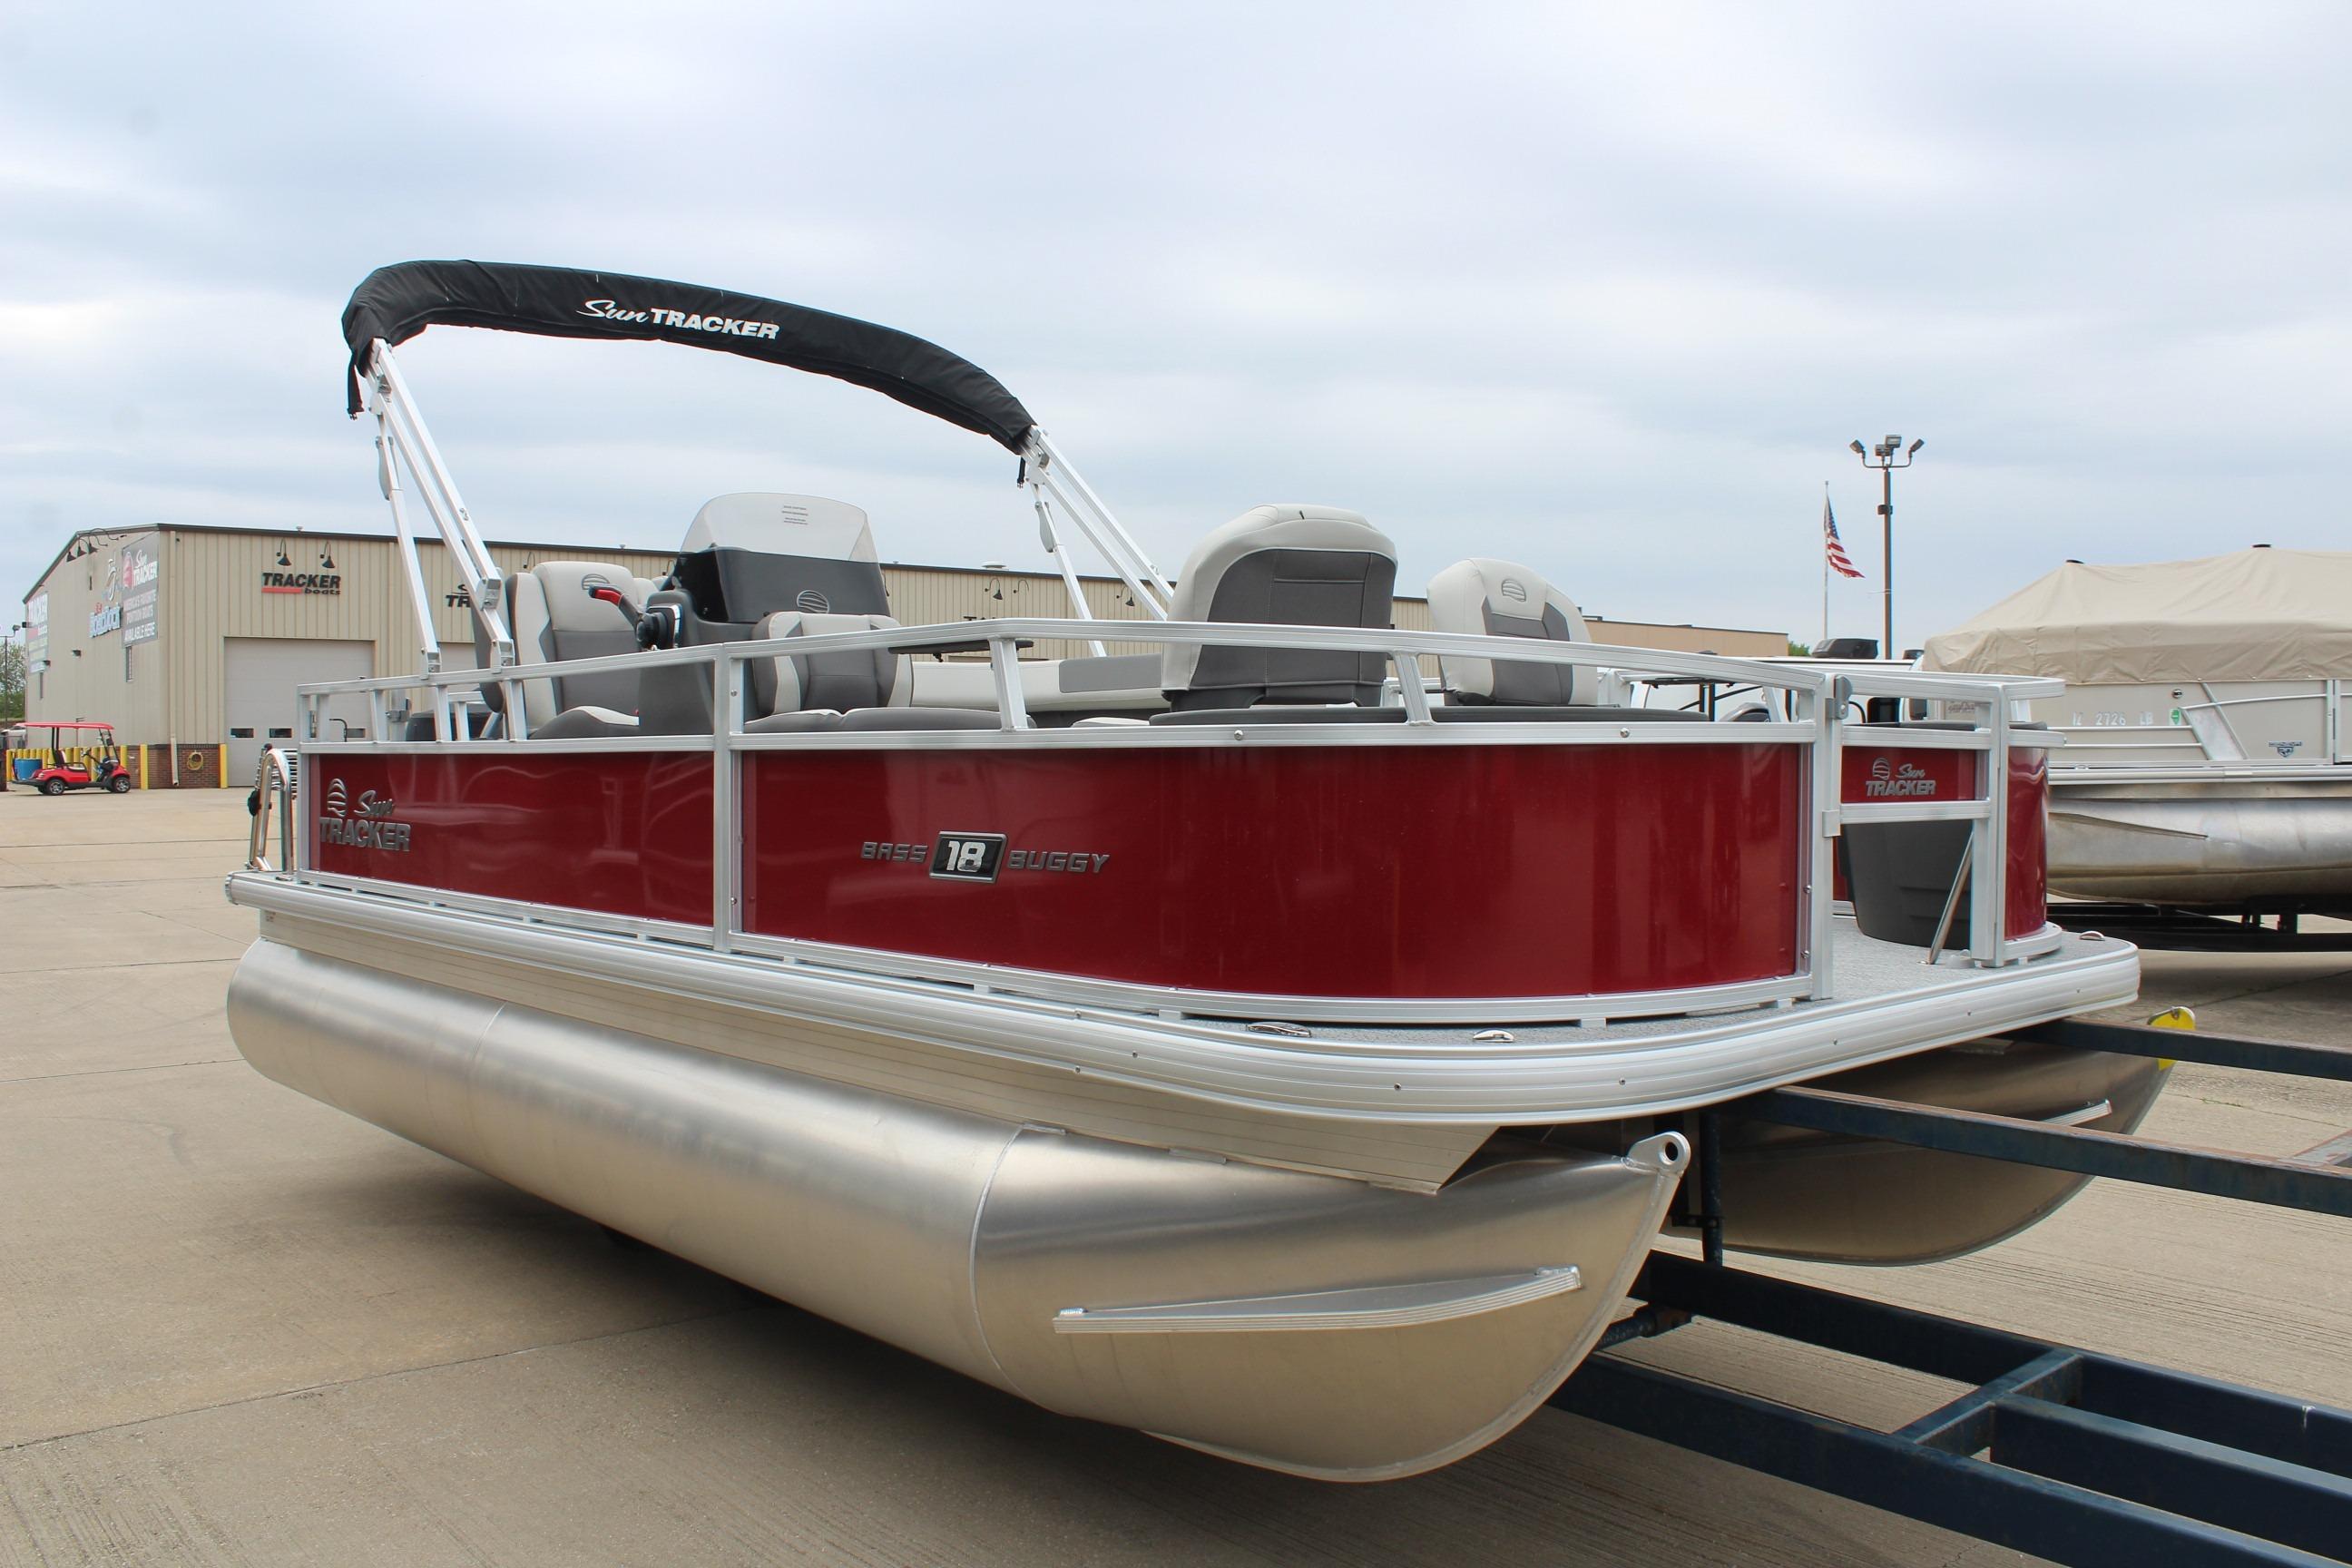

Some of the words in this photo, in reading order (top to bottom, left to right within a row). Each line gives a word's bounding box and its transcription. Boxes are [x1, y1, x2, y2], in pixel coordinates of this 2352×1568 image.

[576, 299, 649, 323] Sun
[650, 308, 780, 339] TRACKER
[133, 561, 158, 587] TRACKER
[261, 573, 341, 589] TRACKER
[304, 587, 341, 595] boats
[2095, 712, 2126, 726] 2726
[1895, 763, 1926, 779] Sun
[1866, 779, 1936, 797] TRACKER
[354, 789, 395, 818] Sun
[319, 816, 411, 852] TRACKER
[861, 841, 928, 863] BASS
[946, 840, 985, 873] 18
[1007, 849, 1110, 874] BUGGY
